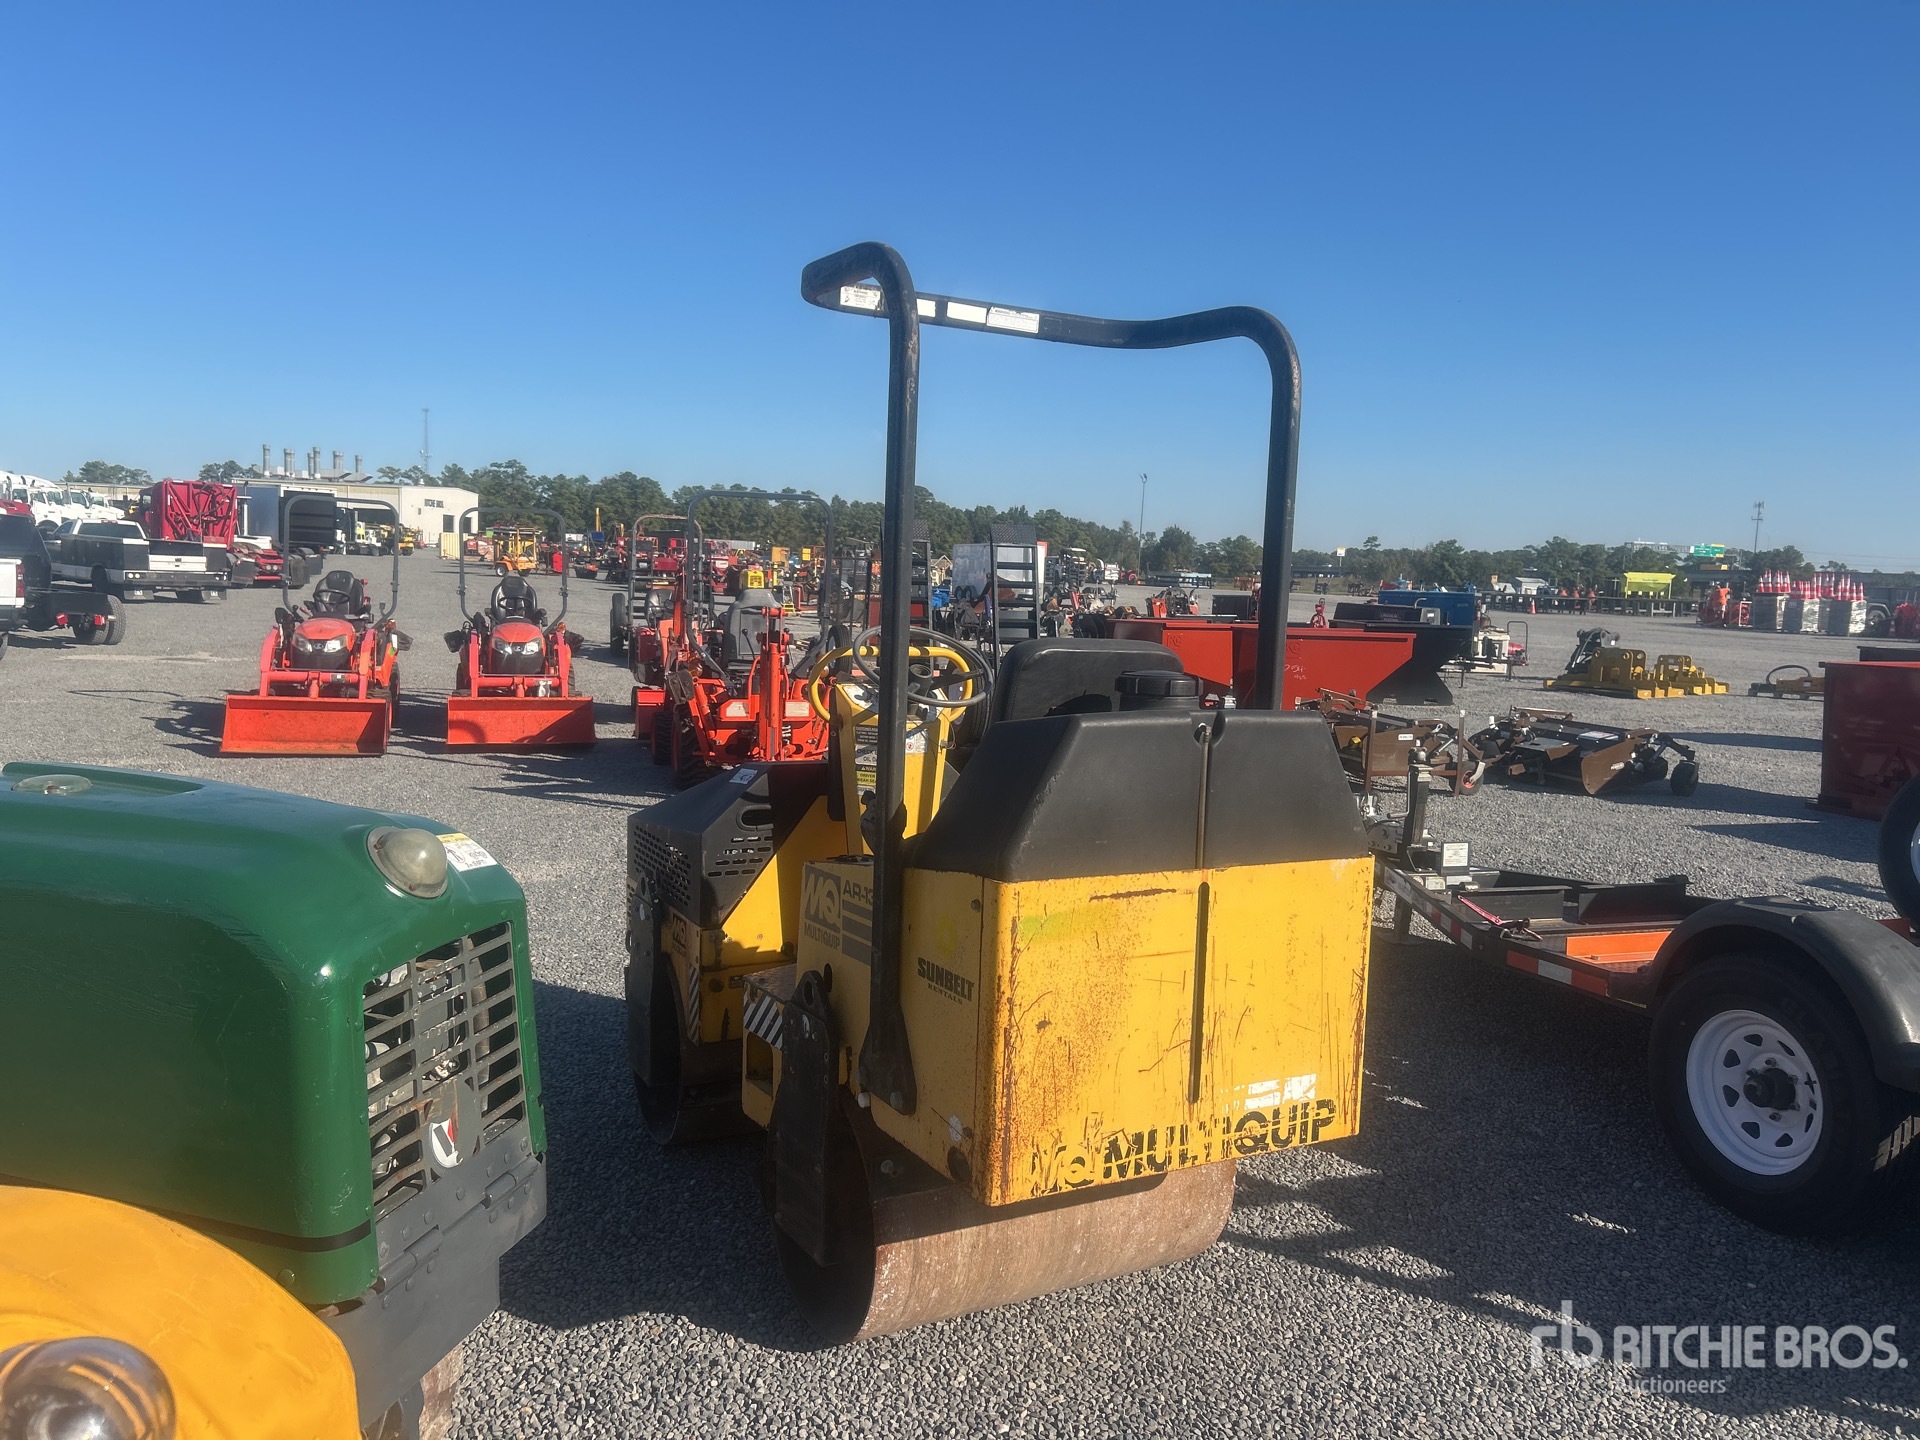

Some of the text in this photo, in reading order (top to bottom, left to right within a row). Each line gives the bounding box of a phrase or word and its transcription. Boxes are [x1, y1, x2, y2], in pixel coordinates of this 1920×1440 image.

[804, 921, 840, 951] MULTIQUIP
[918, 957, 974, 1001] SUNBELT
[927, 982, 963, 1005] RENTALS
